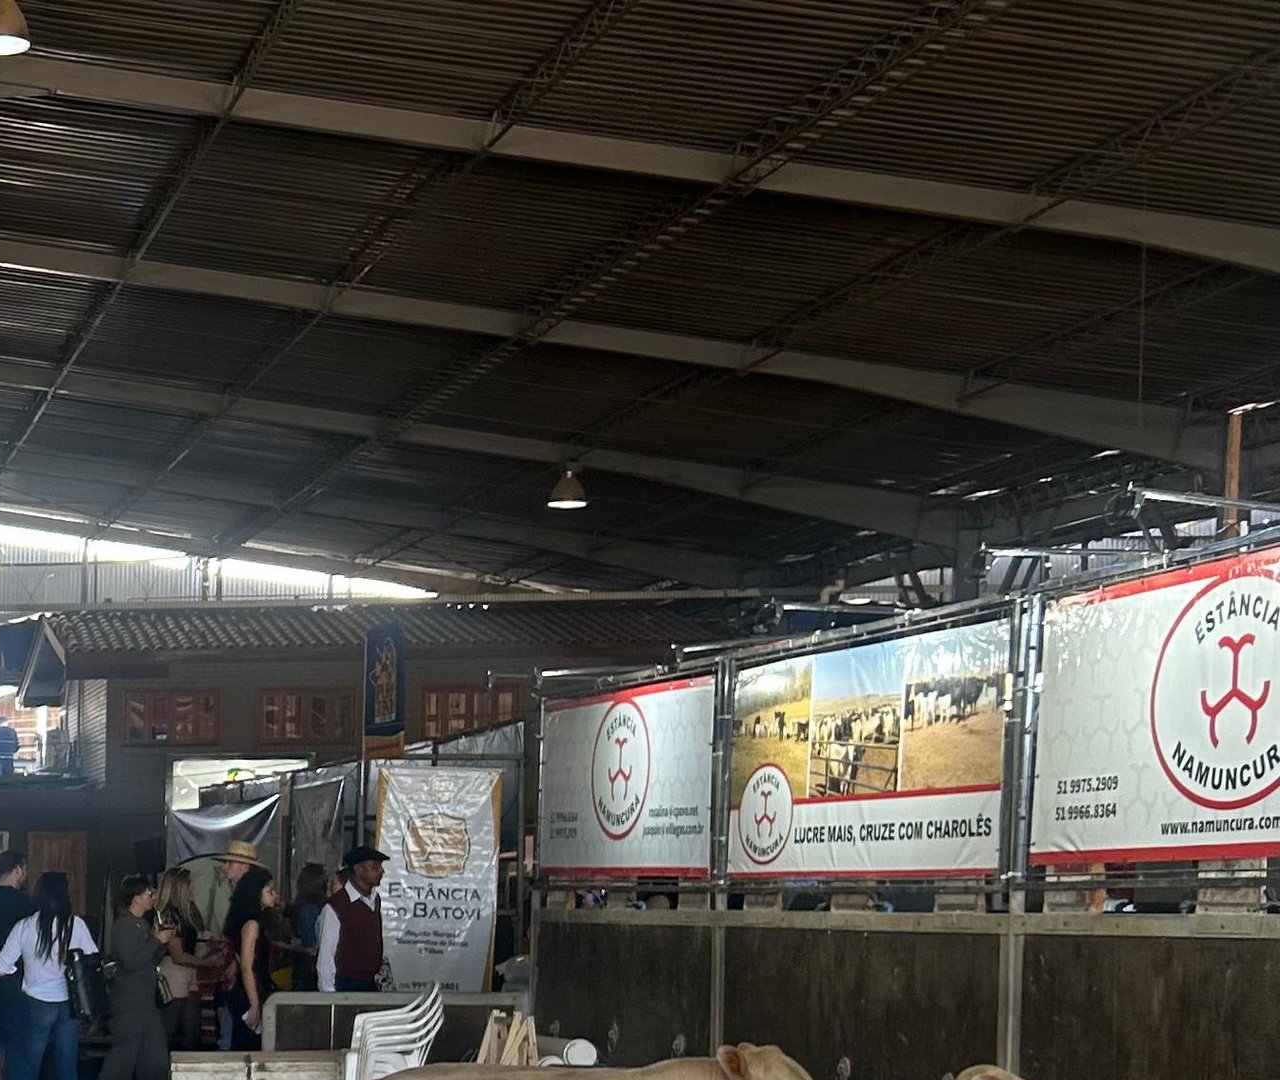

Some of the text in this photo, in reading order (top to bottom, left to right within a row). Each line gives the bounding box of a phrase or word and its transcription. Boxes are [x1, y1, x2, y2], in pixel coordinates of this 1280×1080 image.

[1195, 590, 1280, 644] ESTÂNCIA
[1056, 775, 1119, 795] 51 9975.2909
[1055, 802, 1117, 821] 51 9966.8364
[794, 813, 992, 845] LUCRE MAIS, CRUZE COM CHAROLÊS
[413, 902, 481, 921] BATOVI
